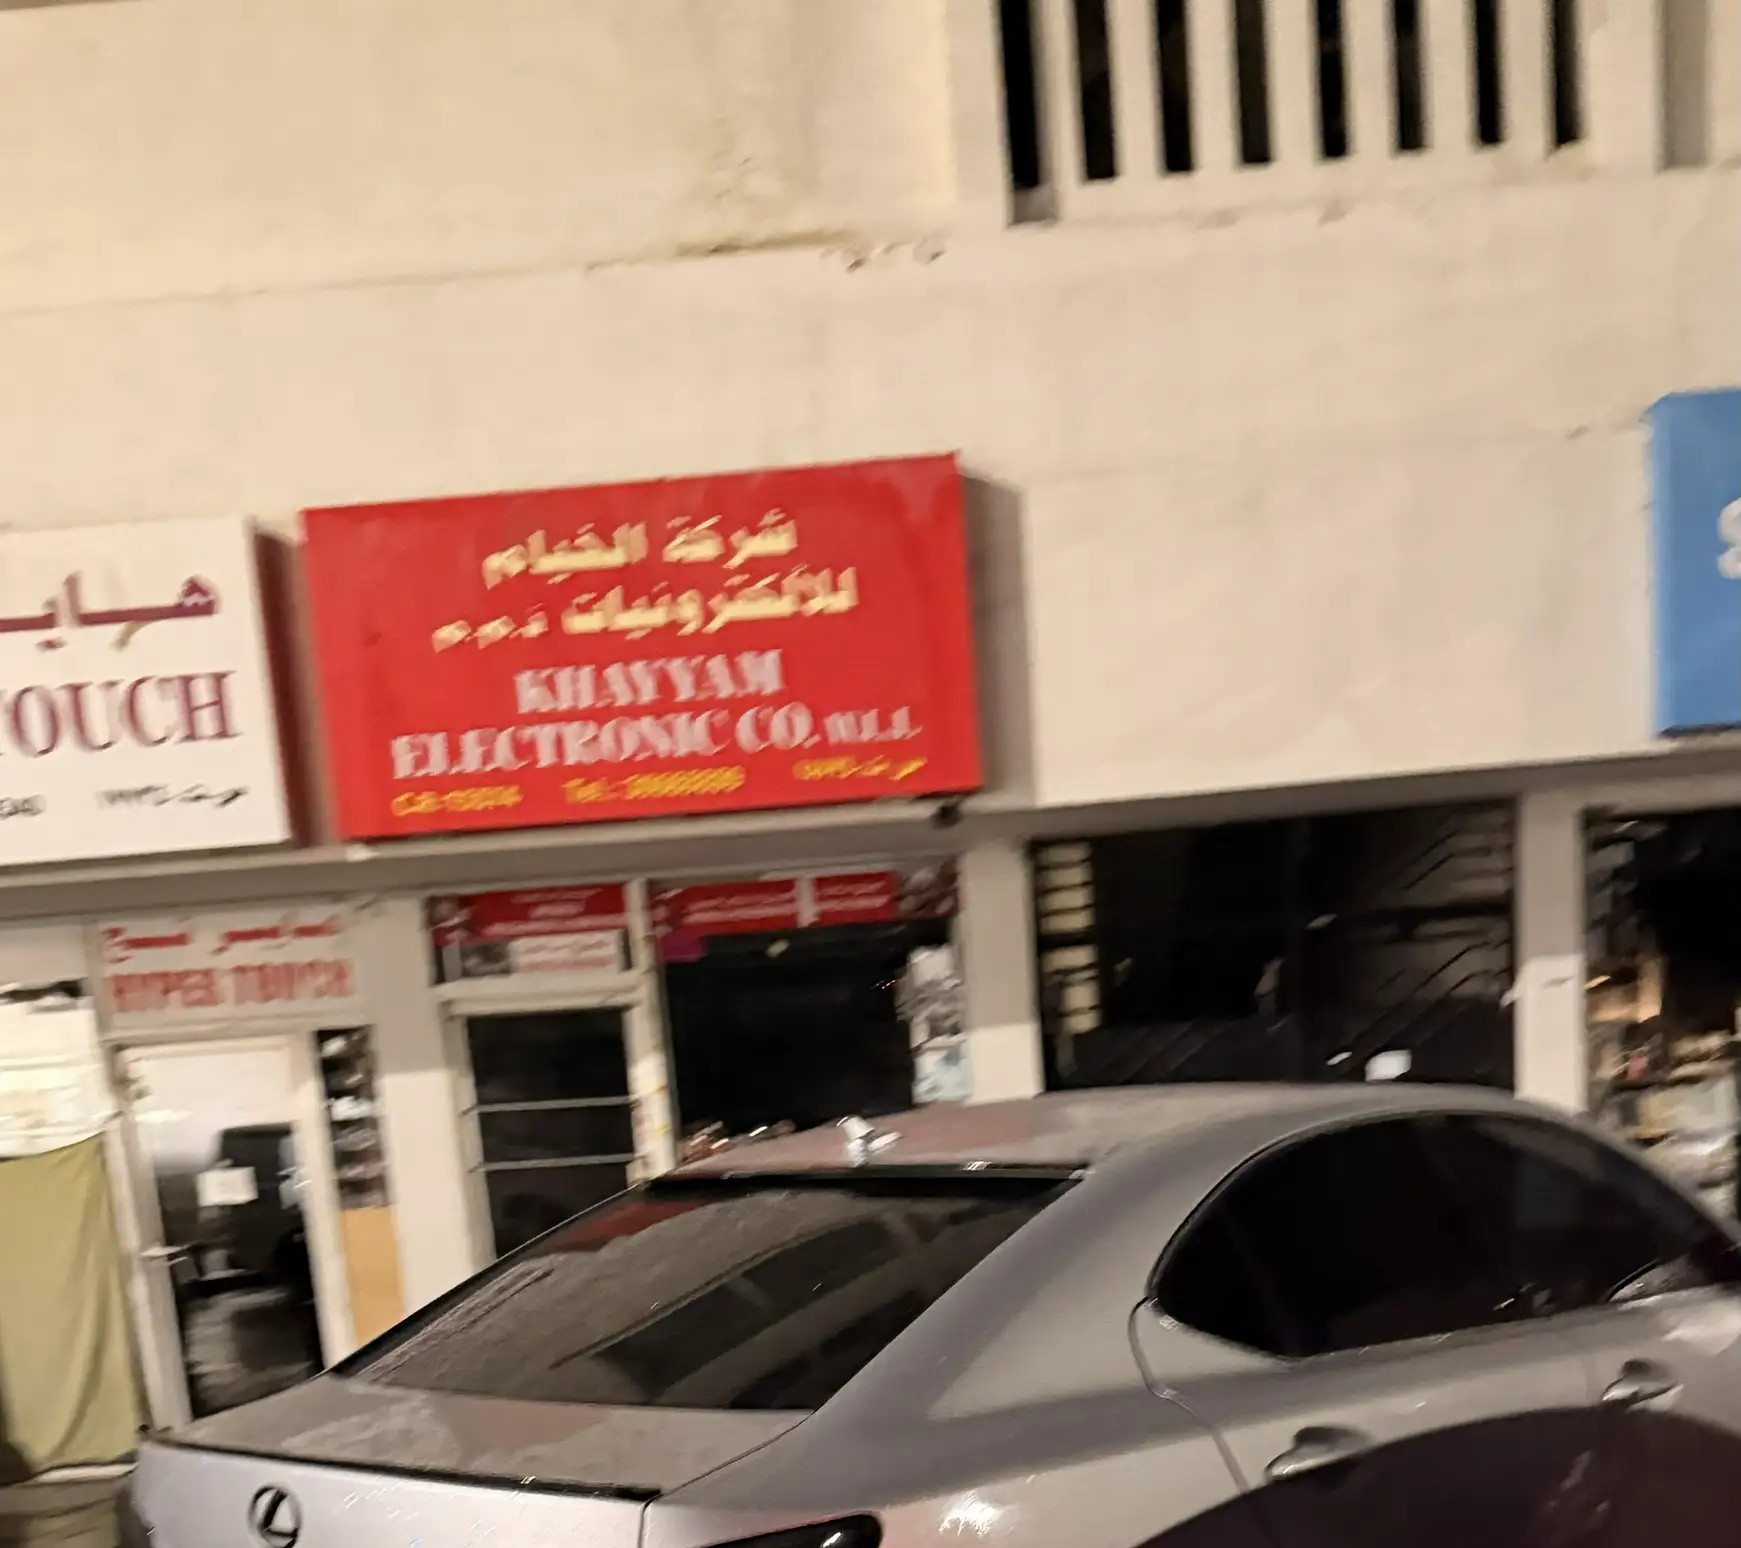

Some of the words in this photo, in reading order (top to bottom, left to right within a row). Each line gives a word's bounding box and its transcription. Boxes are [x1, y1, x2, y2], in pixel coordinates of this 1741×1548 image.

[481, 521, 649, 591] الخيام
[661, 507, 799, 570] شركة
[0, 670, 243, 758] OUCH
[512, 648, 786, 715] KHAYYAM
[390, 709, 729, 780] ELECTRONIC
[734, 701, 821, 753] CO.
